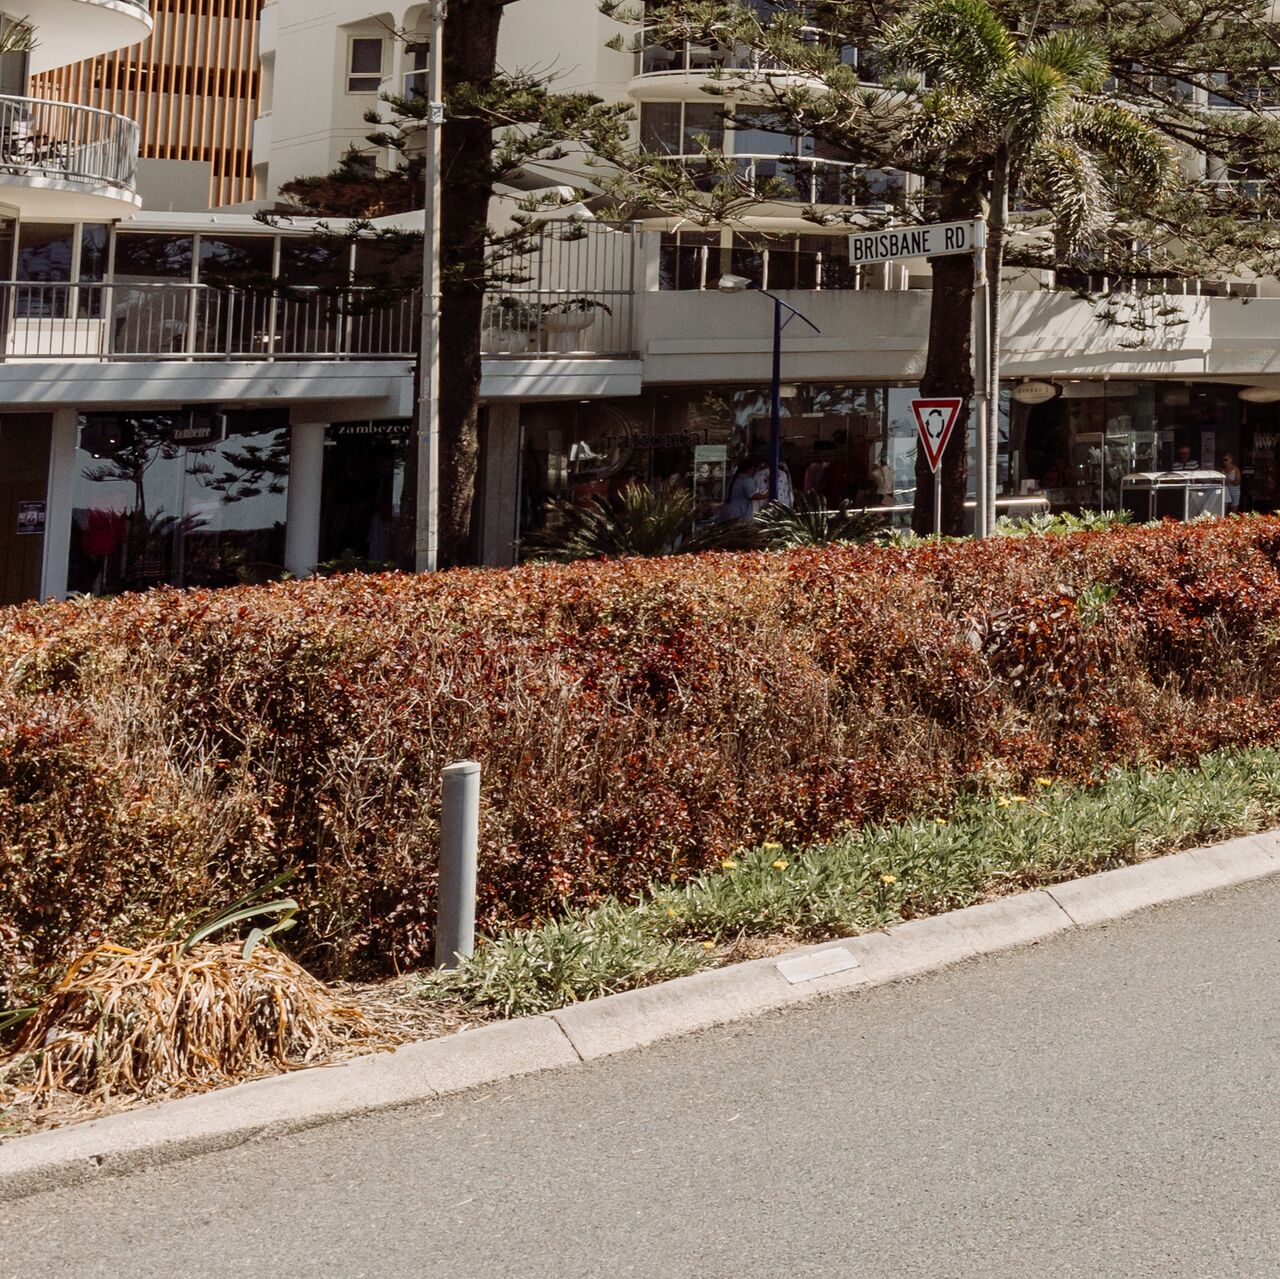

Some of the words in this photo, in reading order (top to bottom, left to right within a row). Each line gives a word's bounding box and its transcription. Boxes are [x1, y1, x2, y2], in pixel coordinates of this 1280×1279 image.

[854, 231, 930, 260] BRISBANE
[945, 227, 965, 251] RD
[338, 420, 410, 435] zambezee
